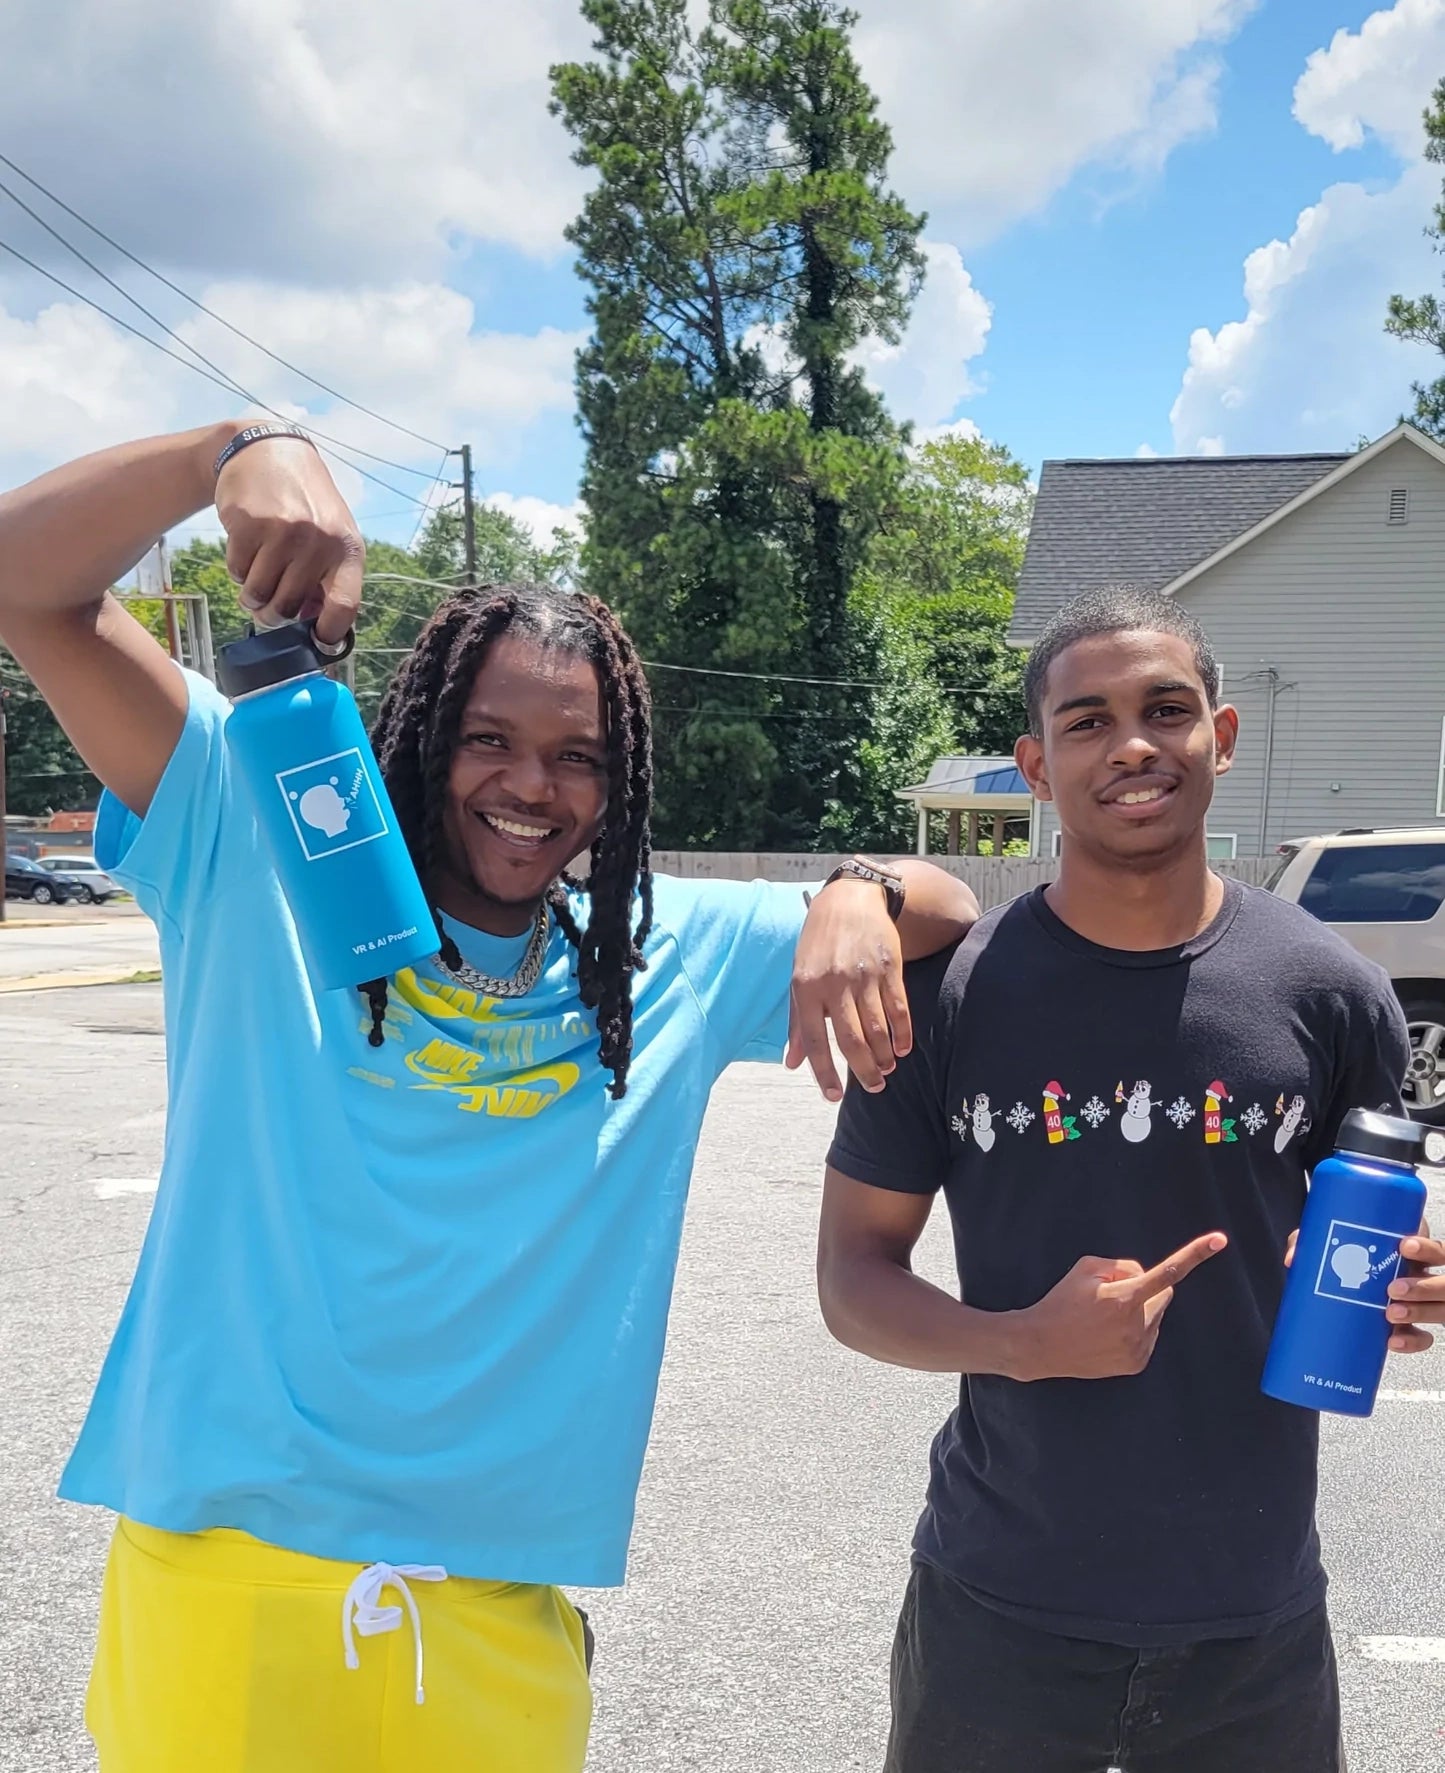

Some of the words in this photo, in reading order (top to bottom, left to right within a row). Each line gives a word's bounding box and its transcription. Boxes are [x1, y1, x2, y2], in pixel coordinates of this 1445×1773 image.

[350, 767, 363, 800] AHHH
[352, 945, 367, 955] VR
[368, 941, 376, 950] &
[377, 937, 387, 948] AI
[387, 926, 418, 943] Product
[415, 1037, 486, 1081] NIKE
[1047, 1114, 1061, 1129] 40
[1206, 1116, 1220, 1129] 40
[1378, 1250, 1399, 1272] AHHH
[1303, 1374, 1316, 1384] VR
[1316, 1377, 1323, 1386] &
[1324, 1380, 1334, 1389] AI
[1335, 1381, 1363, 1394] Product
